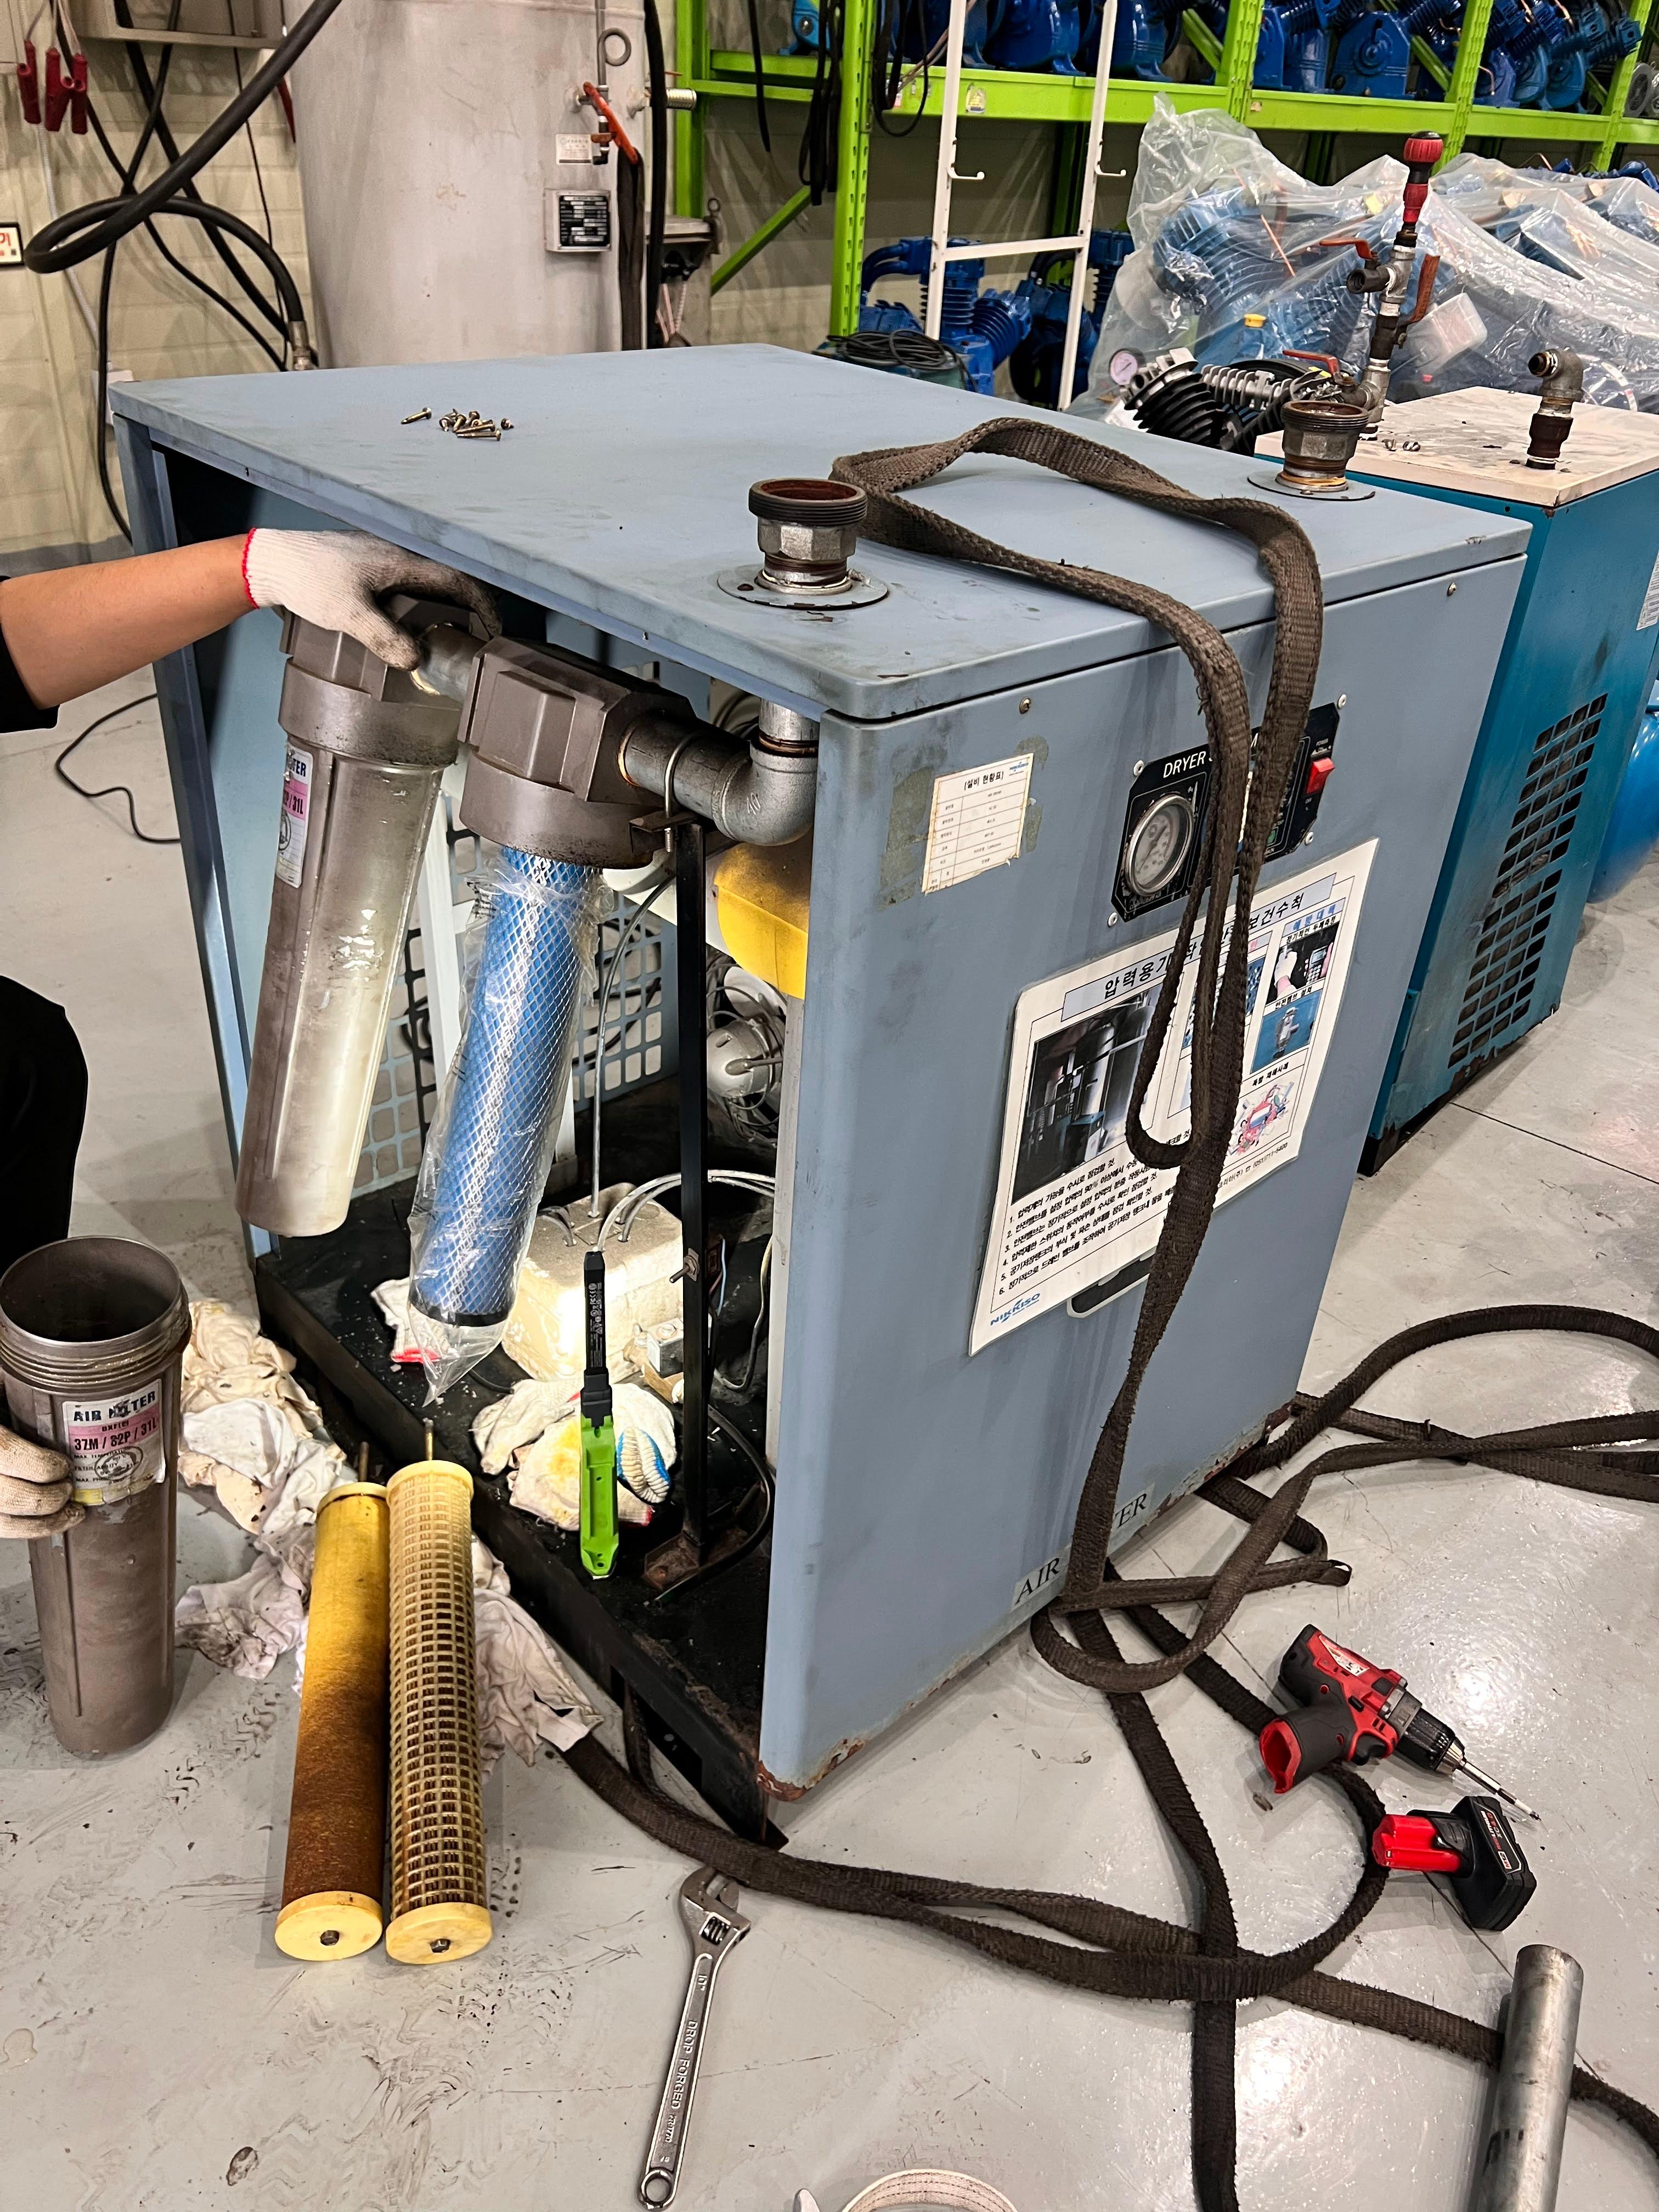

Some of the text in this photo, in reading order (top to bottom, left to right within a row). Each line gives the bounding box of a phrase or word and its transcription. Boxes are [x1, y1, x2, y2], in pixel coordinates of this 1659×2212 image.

[1163, 751, 1206, 778] DRYER
[1105, 952, 1173, 999] 압력용기
[1067, 1175, 1085, 1190] 수시로
[1039, 1225, 1064, 1245] 스위치의
[1098, 1195, 1115, 1210] 수시로
[1048, 1205, 1078, 1228] 정기적으로
[1001, 1273, 1007, 1281] 5.
[1008, 1266, 1039, 1290] 정기적으로
[990, 1294, 1040, 1325] NIKKISO
[74, 1410, 101, 1421] AIR
[75, 1438, 98, 1451] 37M
[1015, 1558, 1060, 1605] AIR
[671, 2021, 698, 2109] DROP FORGED
